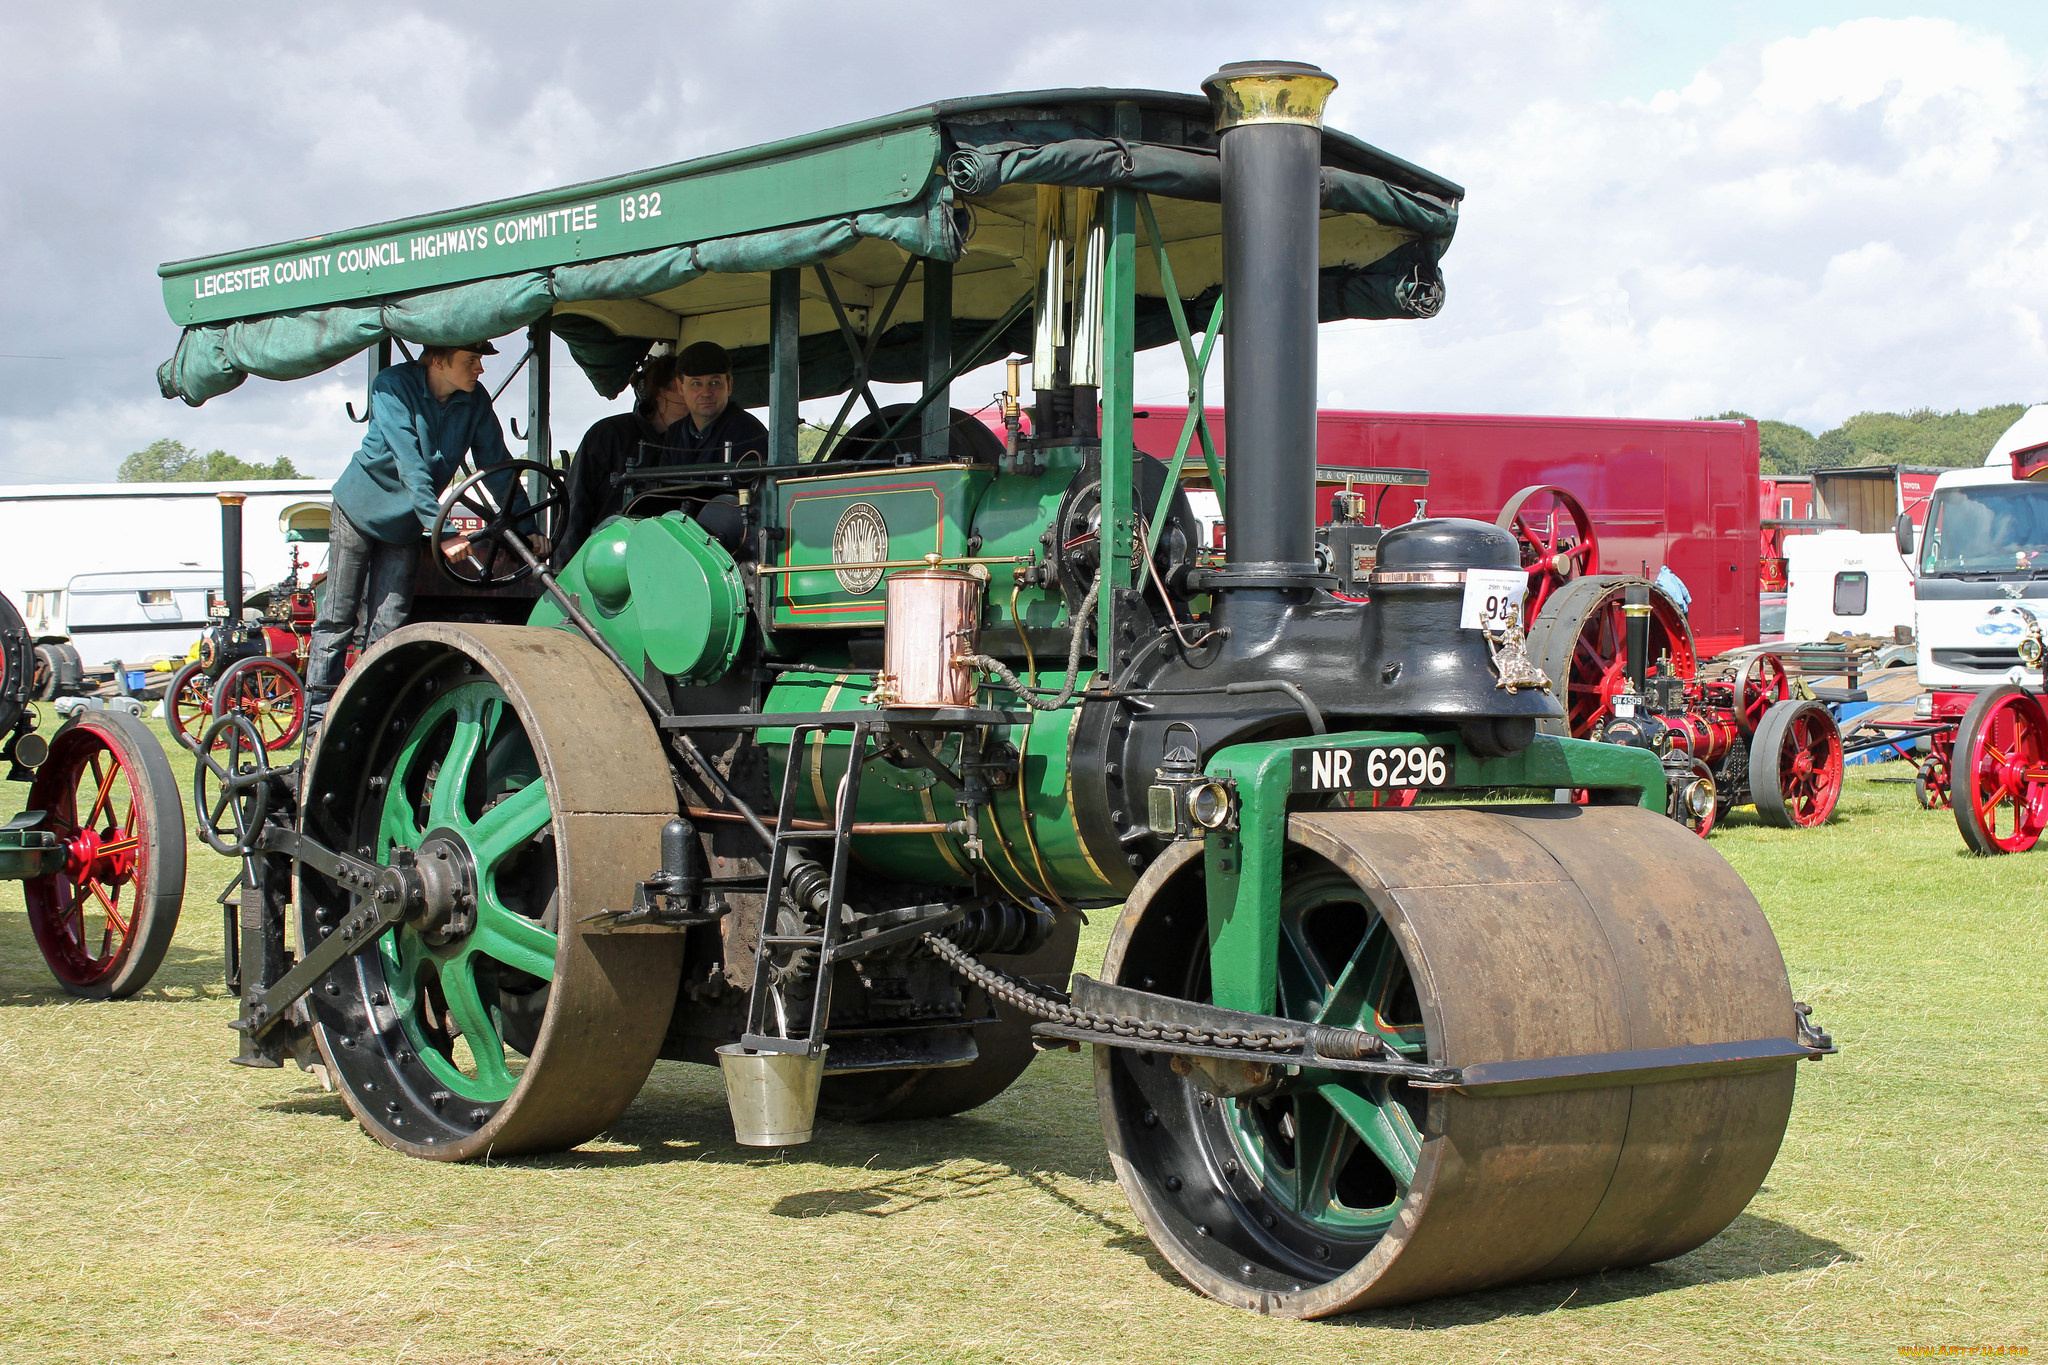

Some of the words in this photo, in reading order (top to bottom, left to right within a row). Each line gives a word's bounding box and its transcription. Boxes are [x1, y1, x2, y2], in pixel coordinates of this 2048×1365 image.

[194, 265, 271, 300] LEICESTER
[274, 253, 332, 285] COUNTY
[337, 241, 406, 274] COUNCIL
[409, 226, 489, 262] HIGHWAYS
[494, 204, 598, 246] COMMITTEE
[619, 191, 662, 224] 1332
[1326, 471, 1333, 479] &
[1351, 473, 1374, 482] STEAM
[1375, 474, 1403, 483] HAULAGE
[1903, 482, 1921, 490] TOYOTA
[1486, 596, 1509, 621] 93
[1311, 750, 1353, 790] NR
[1367, 746, 1446, 787] 6296
